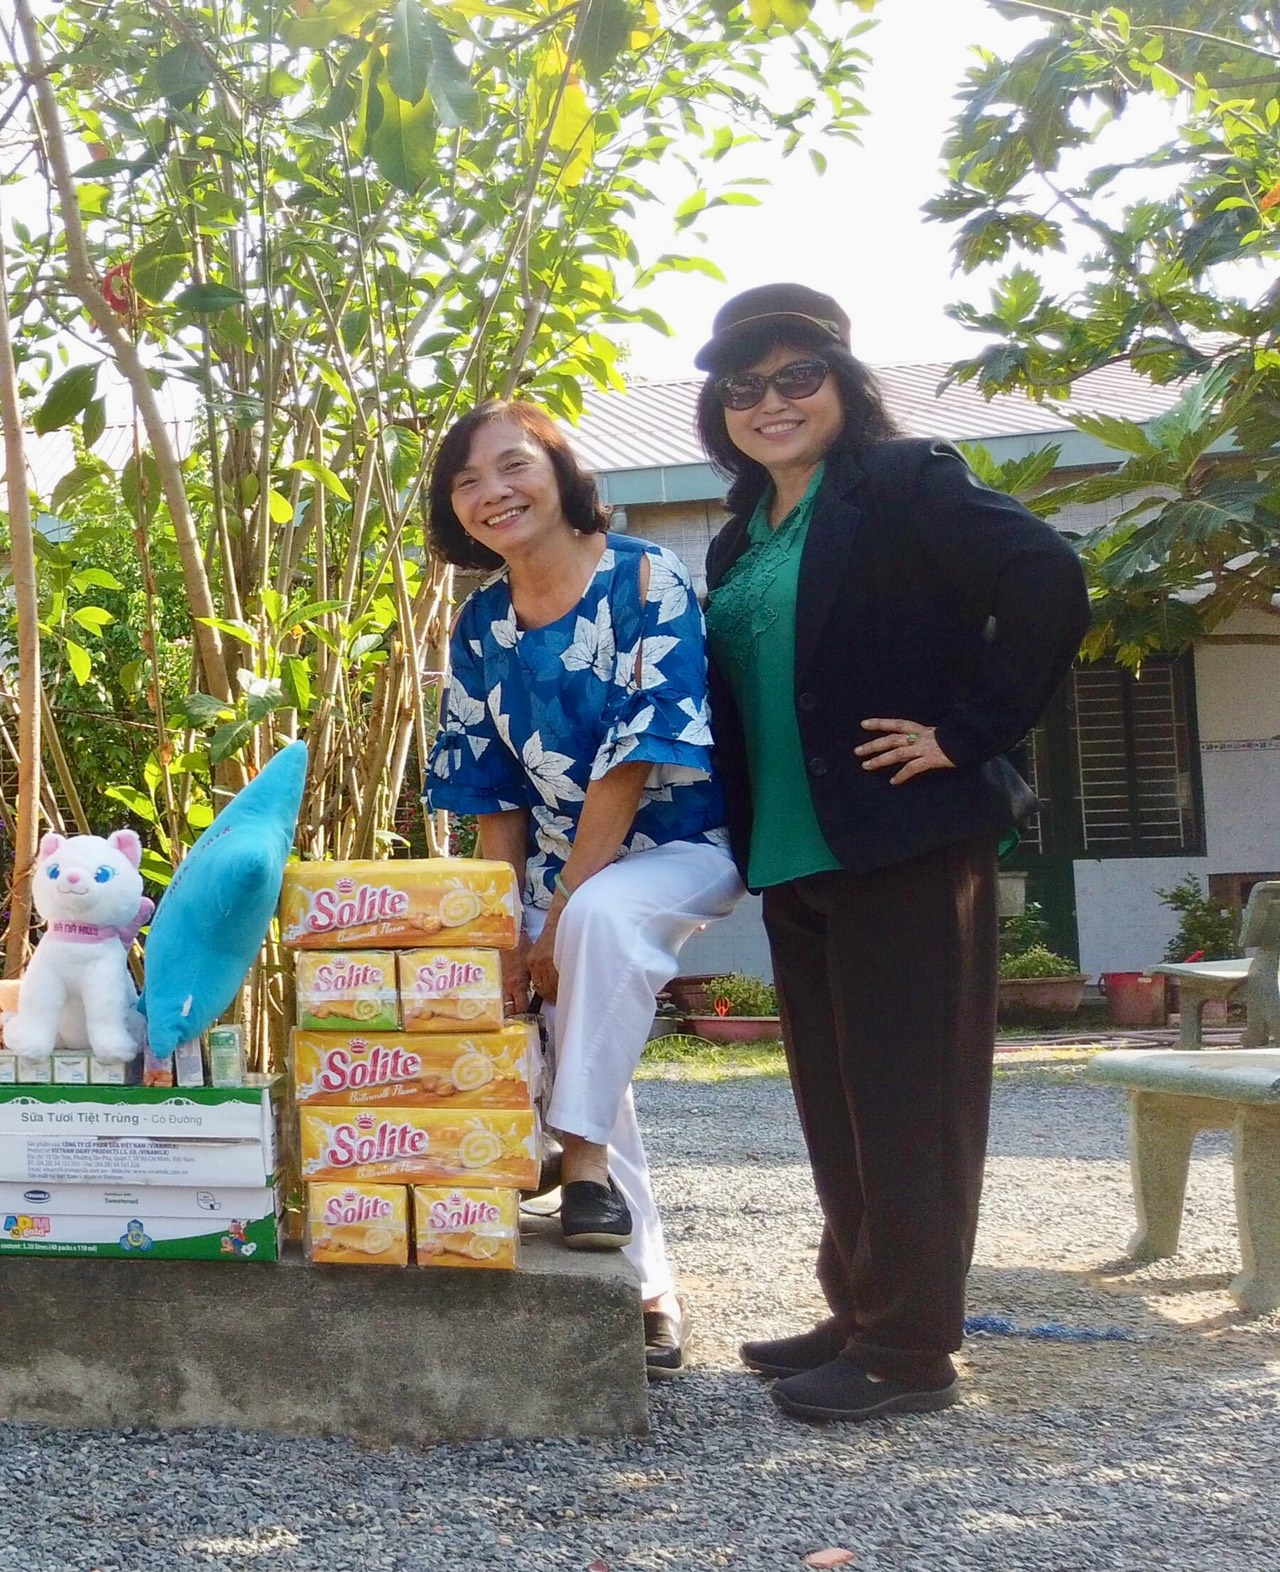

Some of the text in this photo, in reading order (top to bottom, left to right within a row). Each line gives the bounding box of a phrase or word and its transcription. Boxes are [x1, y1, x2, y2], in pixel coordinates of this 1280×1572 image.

[309, 886, 407, 931] Solite
[314, 962, 383, 992] Solite
[415, 962, 484, 993] Solite
[320, 1047, 420, 1091] Solite
[21, 1112, 44, 1123] Sữa
[47, 1112, 74, 1123] Tươi
[77, 1112, 100, 1125] Tiệt
[103, 1112, 139, 1126] Trùng
[169, 1114, 203, 1126] Đường
[328, 1123, 428, 1166] Solite
[3, 1215, 51, 1233] ADM
[322, 1196, 392, 1226] Solite
[427, 1200, 500, 1229] Solite
[22, 1228, 47, 1238] gold
